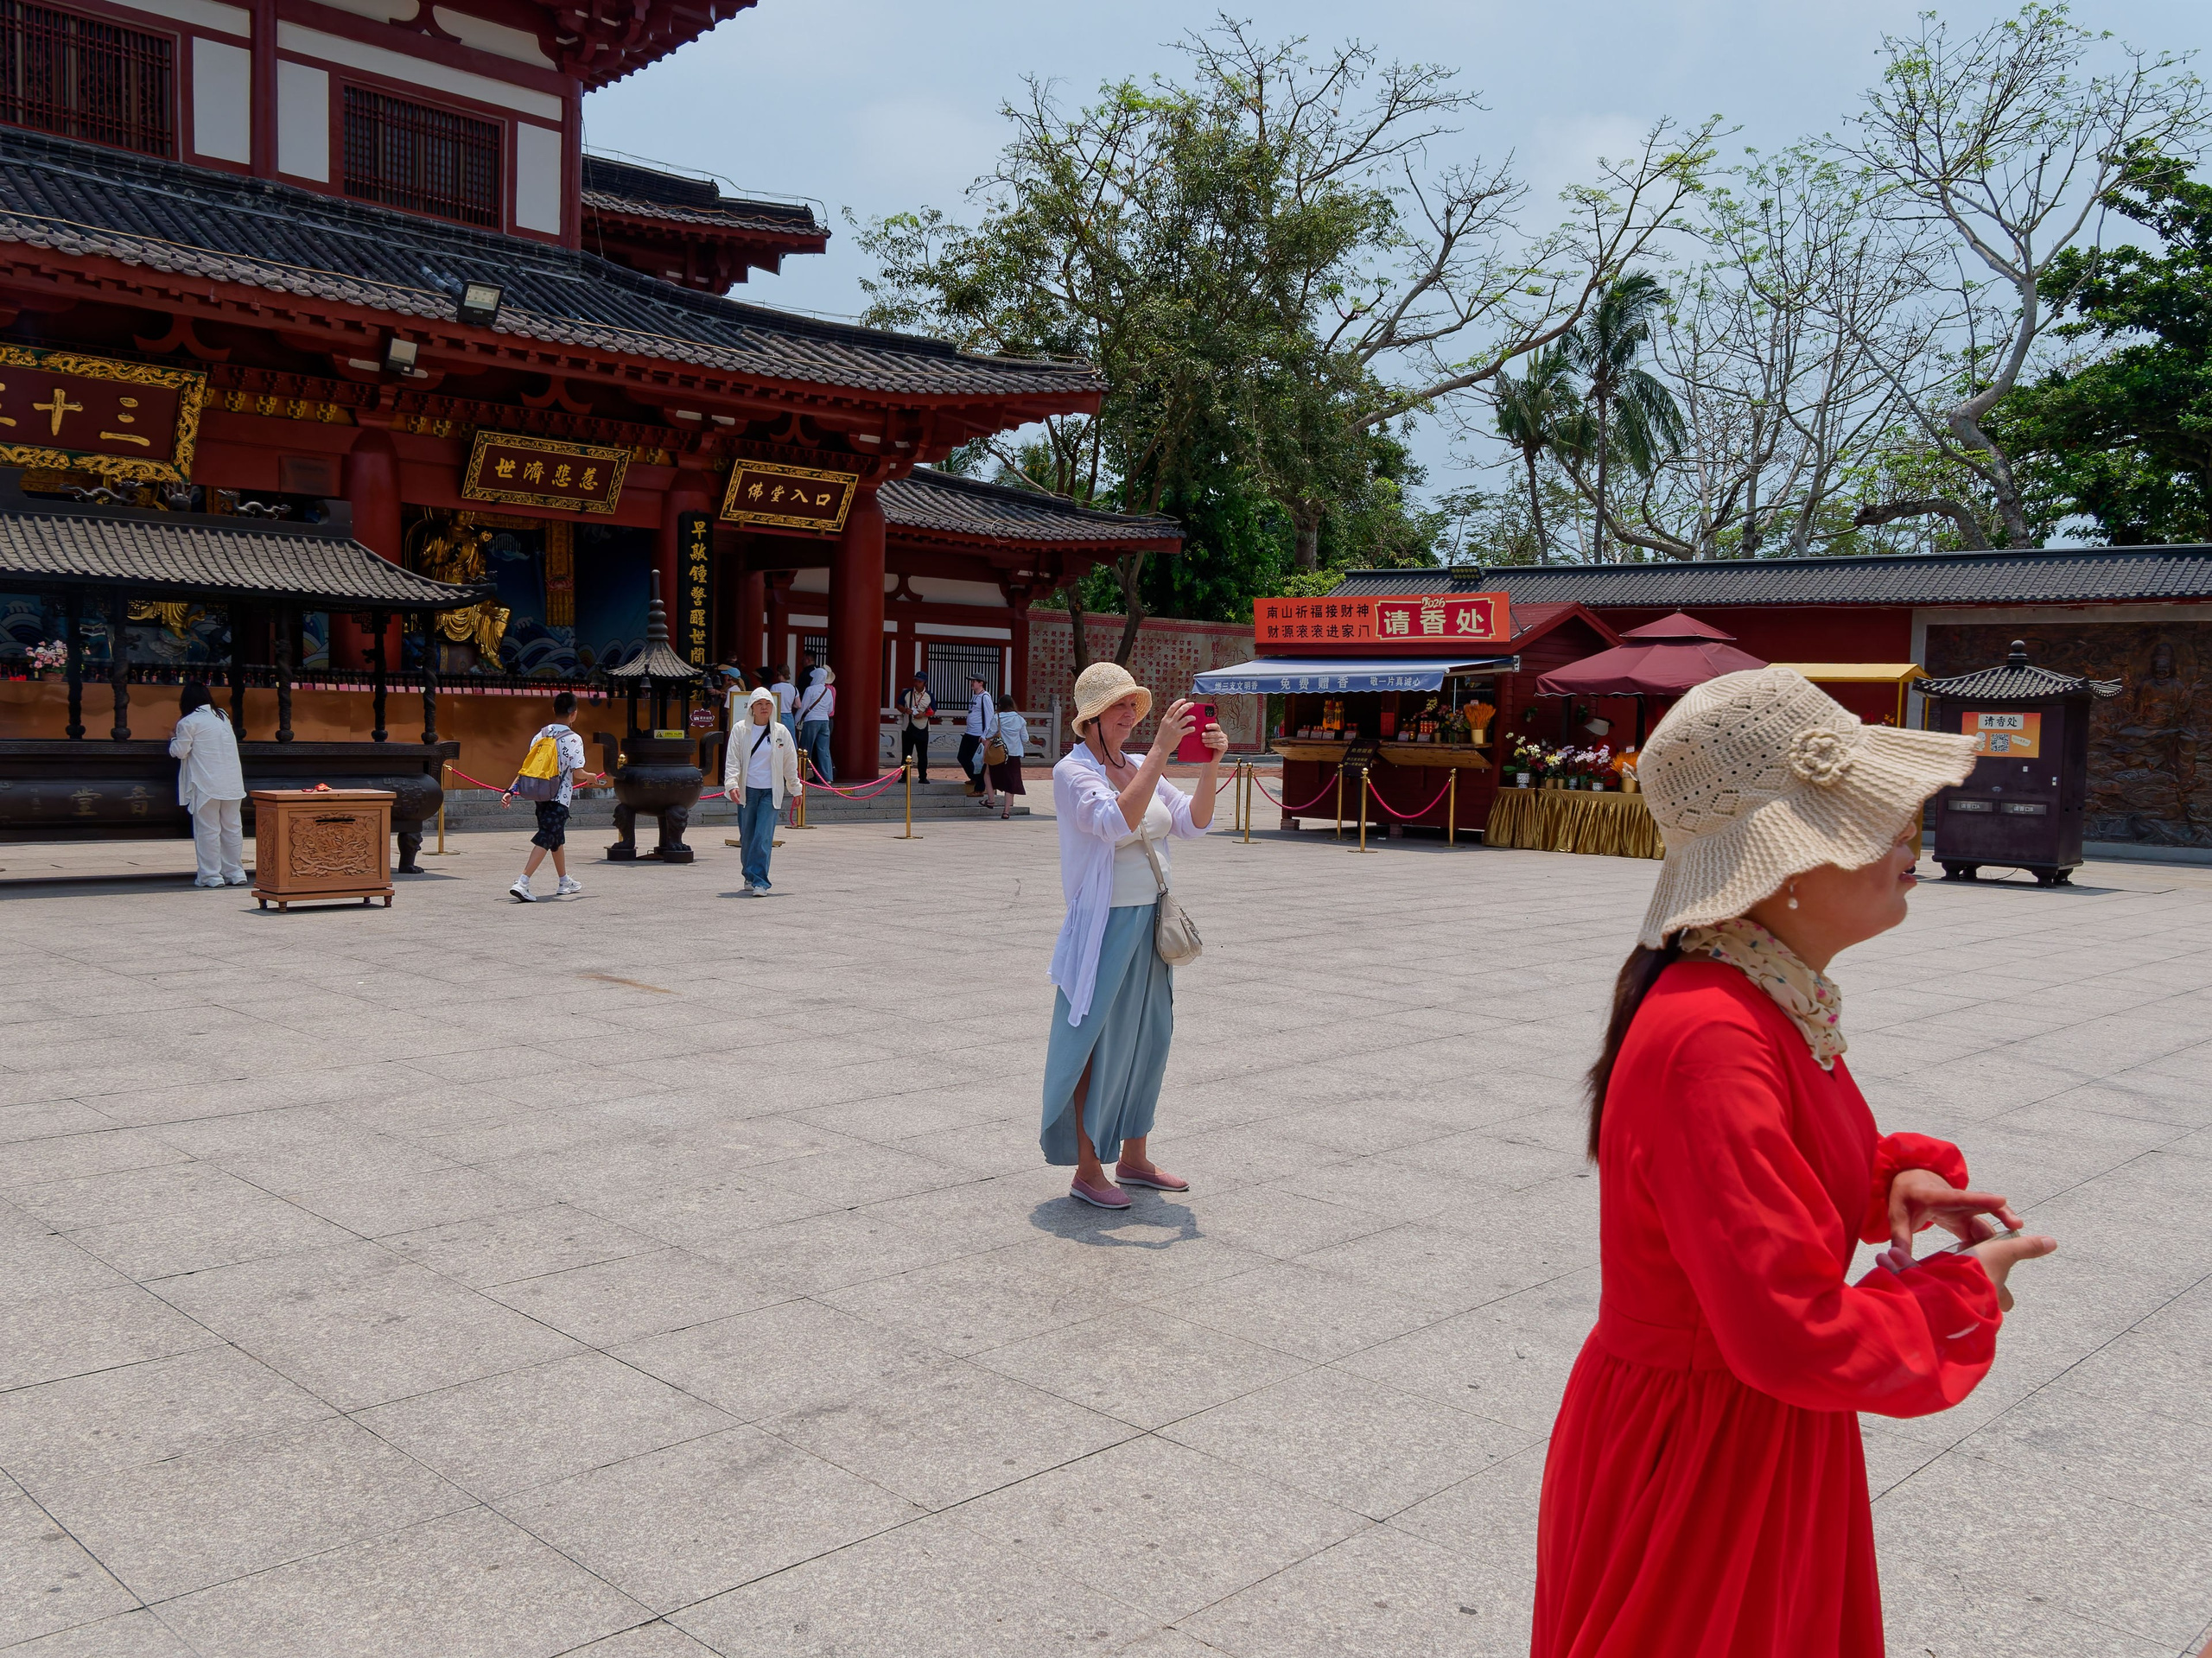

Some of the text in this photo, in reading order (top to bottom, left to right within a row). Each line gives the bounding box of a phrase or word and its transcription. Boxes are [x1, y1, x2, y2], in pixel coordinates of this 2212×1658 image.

[747, 481, 831, 506] 佛堂入口
[1267, 603, 1370, 619] 南山祈福接财神
[1421, 596, 1446, 611] 2026
[1383, 607, 1485, 636] 请香处
[1268, 624, 1370, 638] 财源滚滚进家门
[1280, 677, 1349, 690] 免费赠香
[1984, 715, 2018, 727] 请香处
